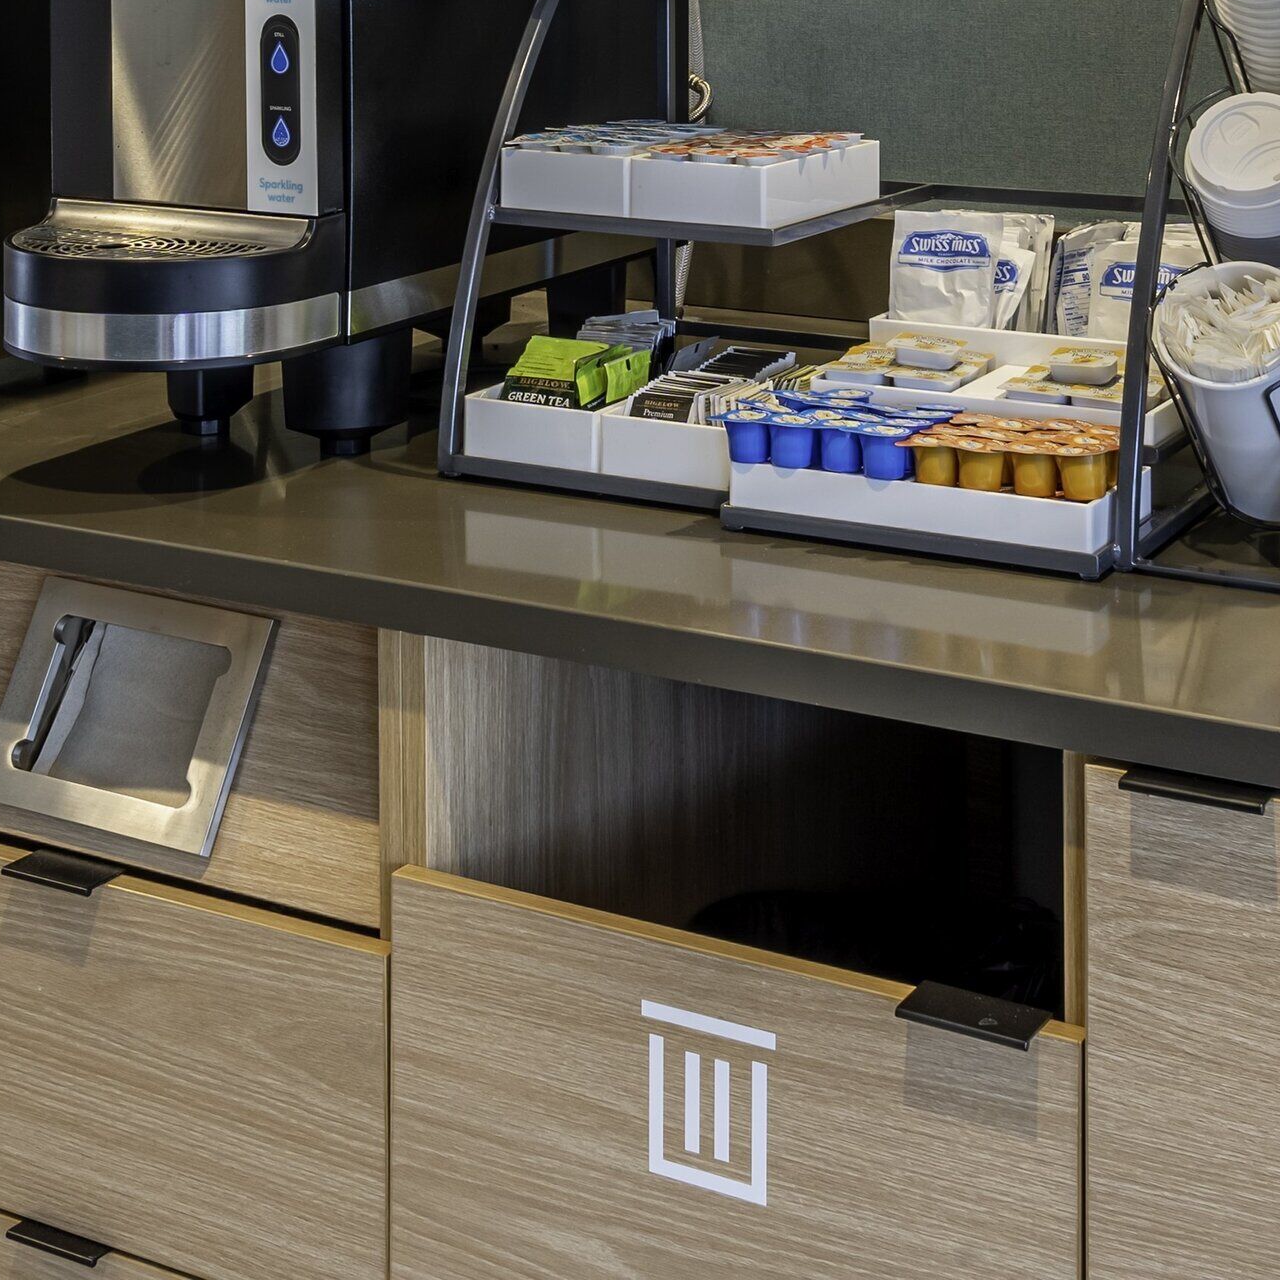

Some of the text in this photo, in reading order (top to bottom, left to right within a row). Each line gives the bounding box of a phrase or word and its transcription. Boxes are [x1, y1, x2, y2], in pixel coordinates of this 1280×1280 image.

[259, 178, 303, 194] Sparkling
[267, 193, 296, 204] water
[519, 377, 570, 389] BIGELOW
[508, 391, 547, 406] GREEN
[549, 396, 570, 408] TEA
[643, 408, 674, 419] Premium
